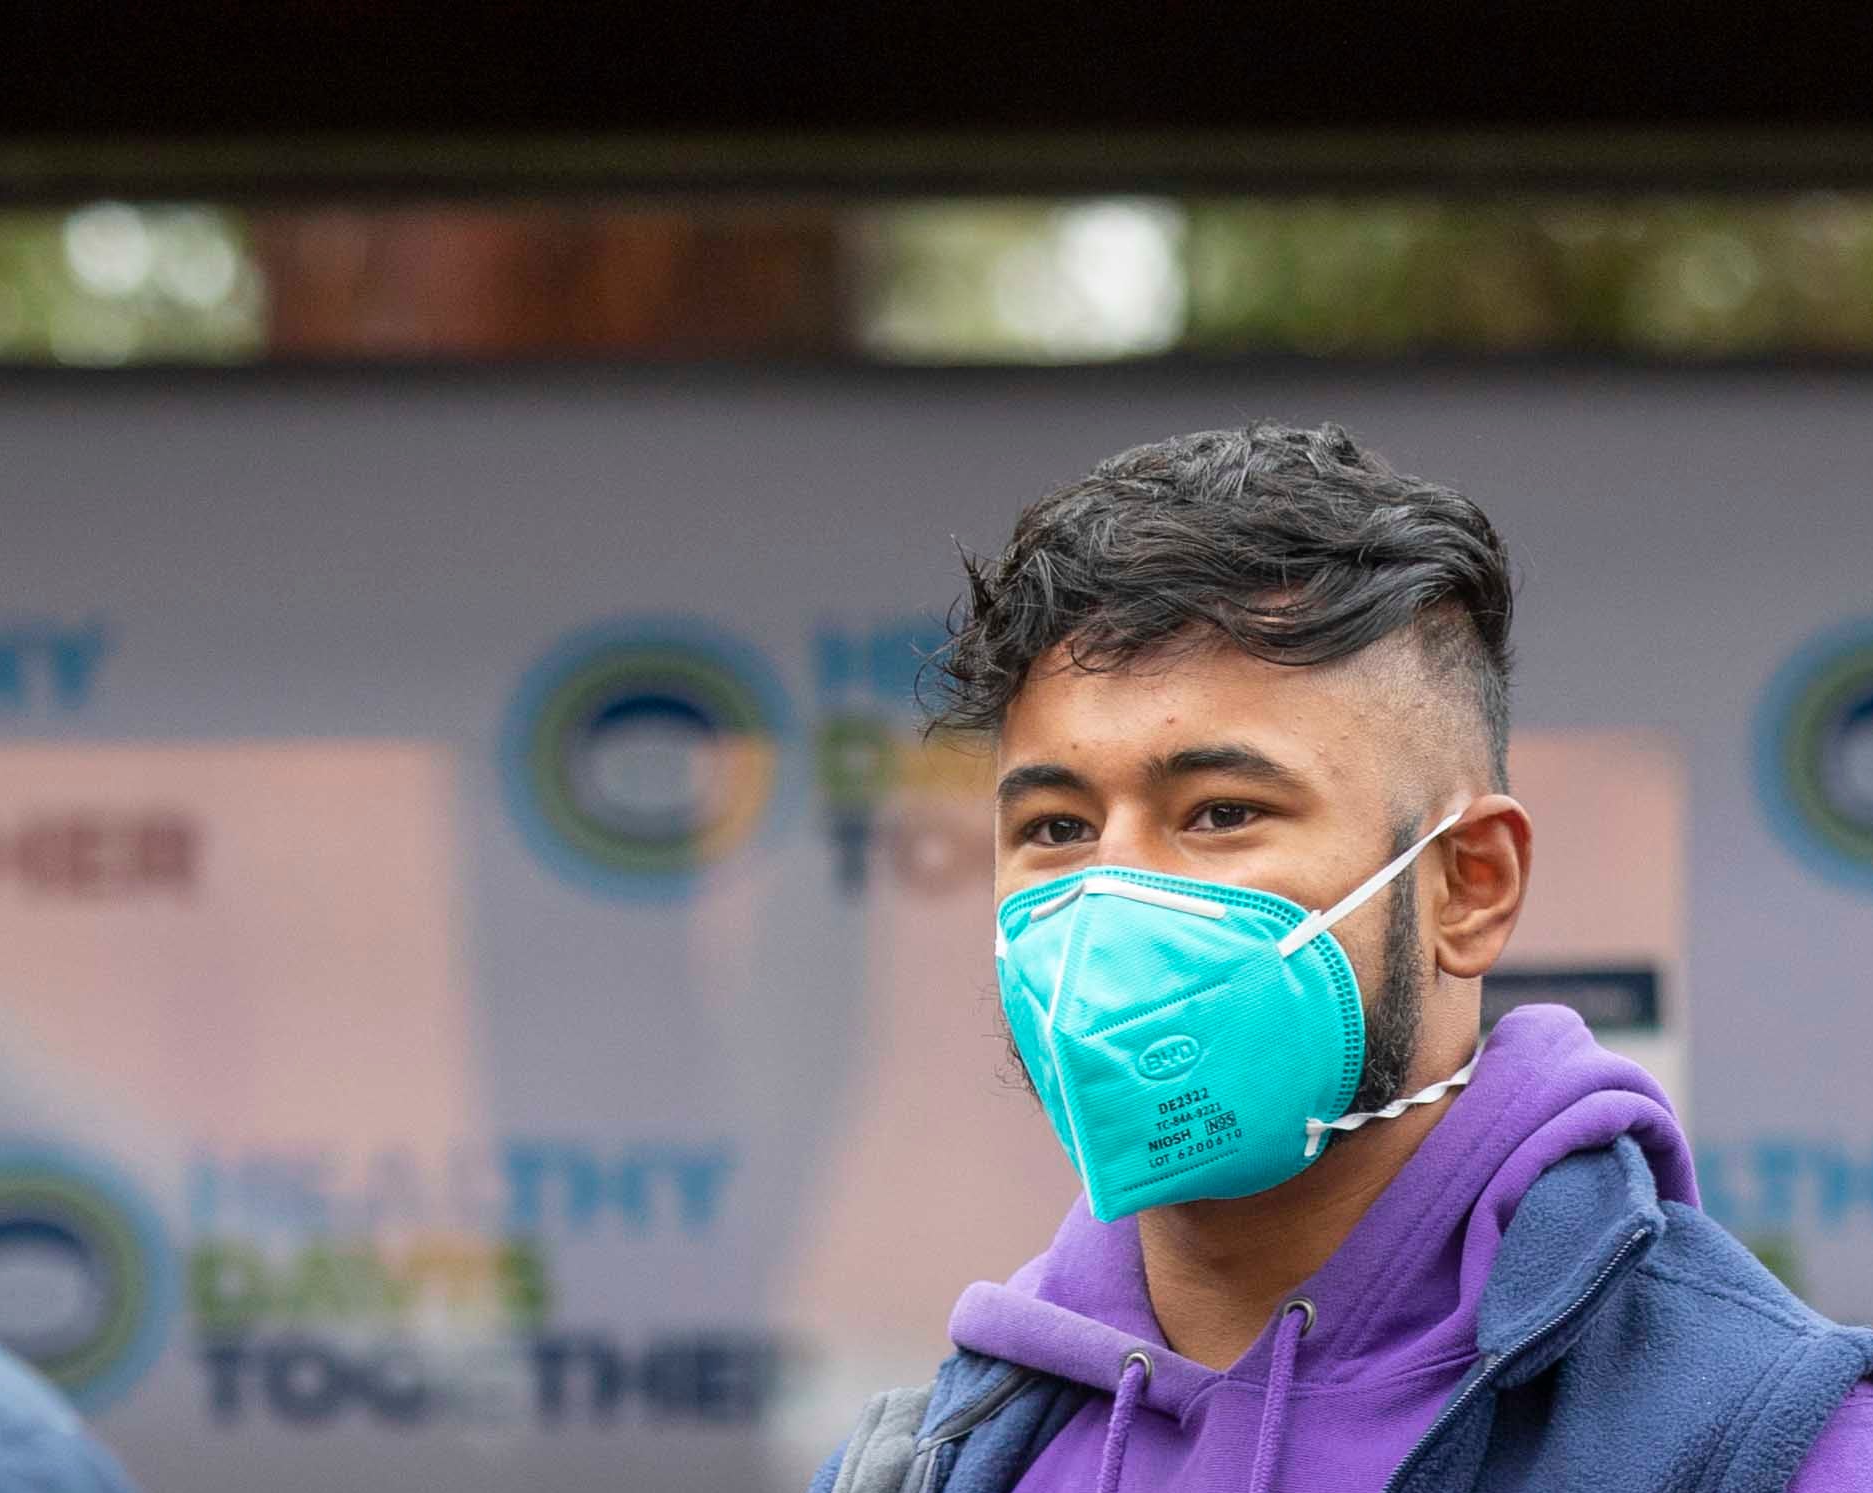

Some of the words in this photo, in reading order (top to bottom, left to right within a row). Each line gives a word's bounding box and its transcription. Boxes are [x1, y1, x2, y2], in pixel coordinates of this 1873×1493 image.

[1158, 1087, 1210, 1115] DE2322
[1149, 1128, 1191, 1152] NIOSH
[1206, 1112, 1236, 1134] N95
[1150, 1154, 1170, 1168] LOT
